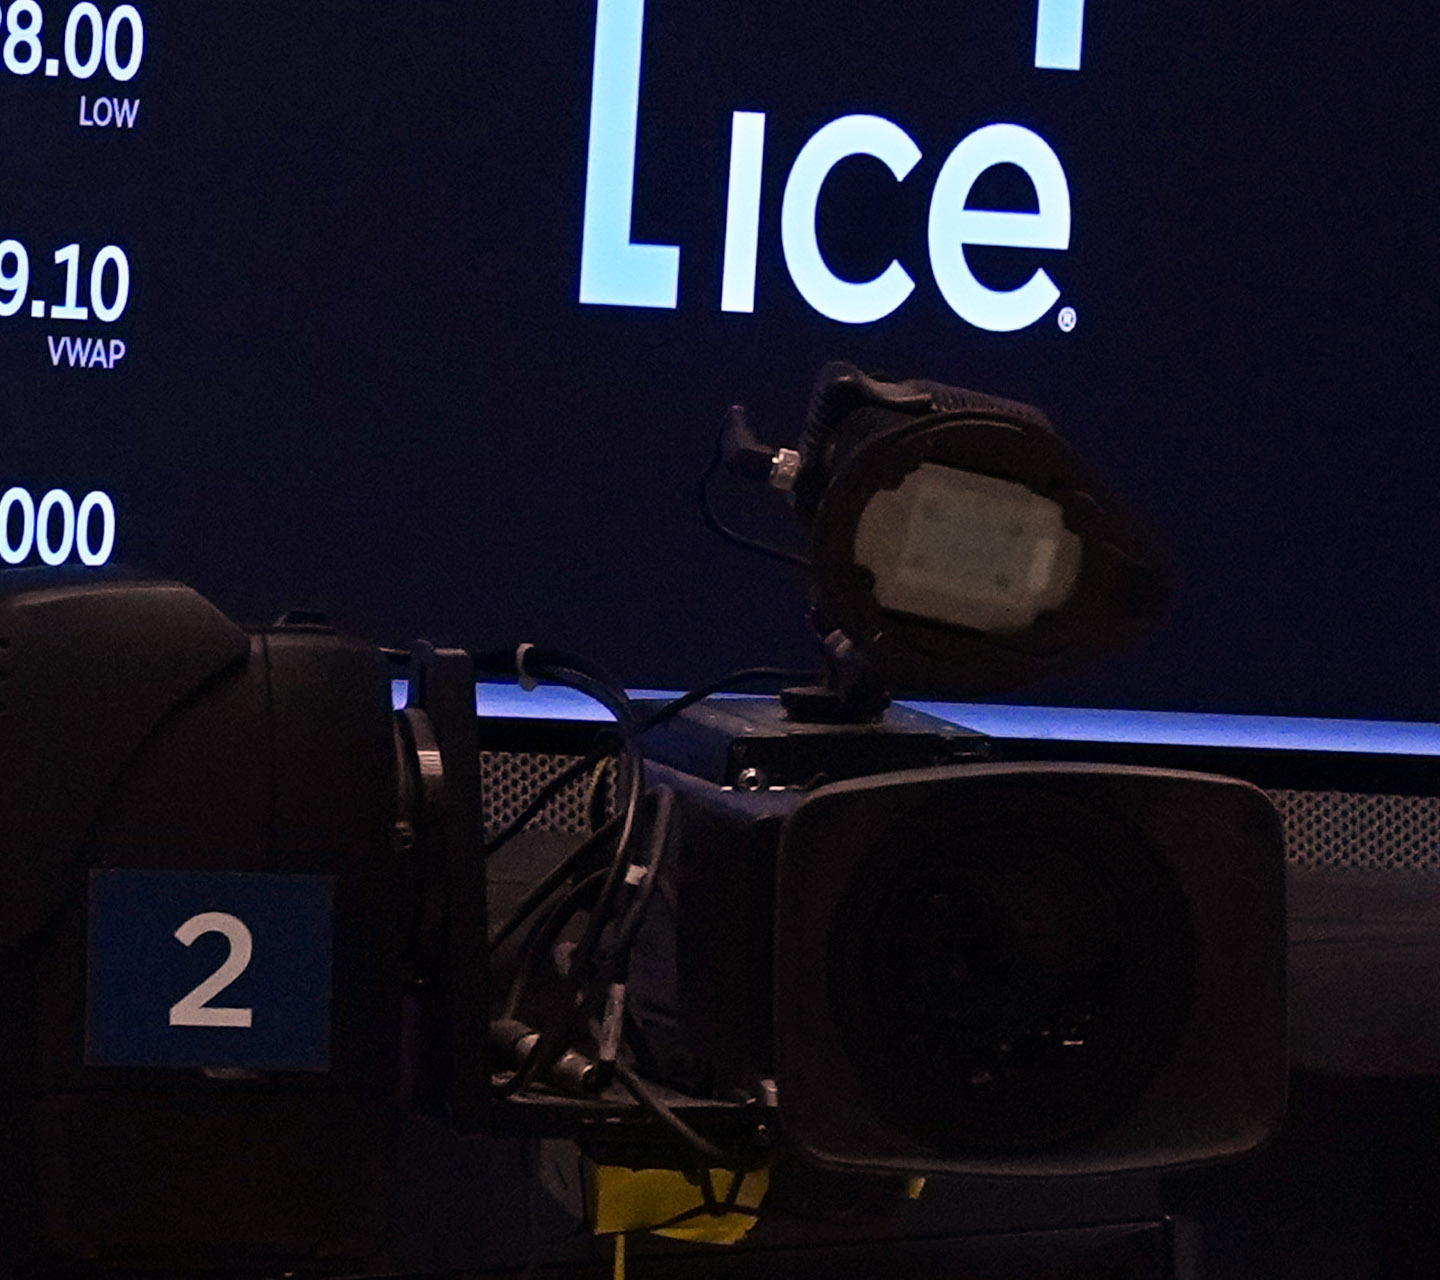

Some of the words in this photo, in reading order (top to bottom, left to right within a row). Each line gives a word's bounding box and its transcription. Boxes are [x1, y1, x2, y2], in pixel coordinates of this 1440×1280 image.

[79, 94, 141, 129] LOW
[46, 335, 127, 369] VWAP
[169, 911, 253, 1028] 2
